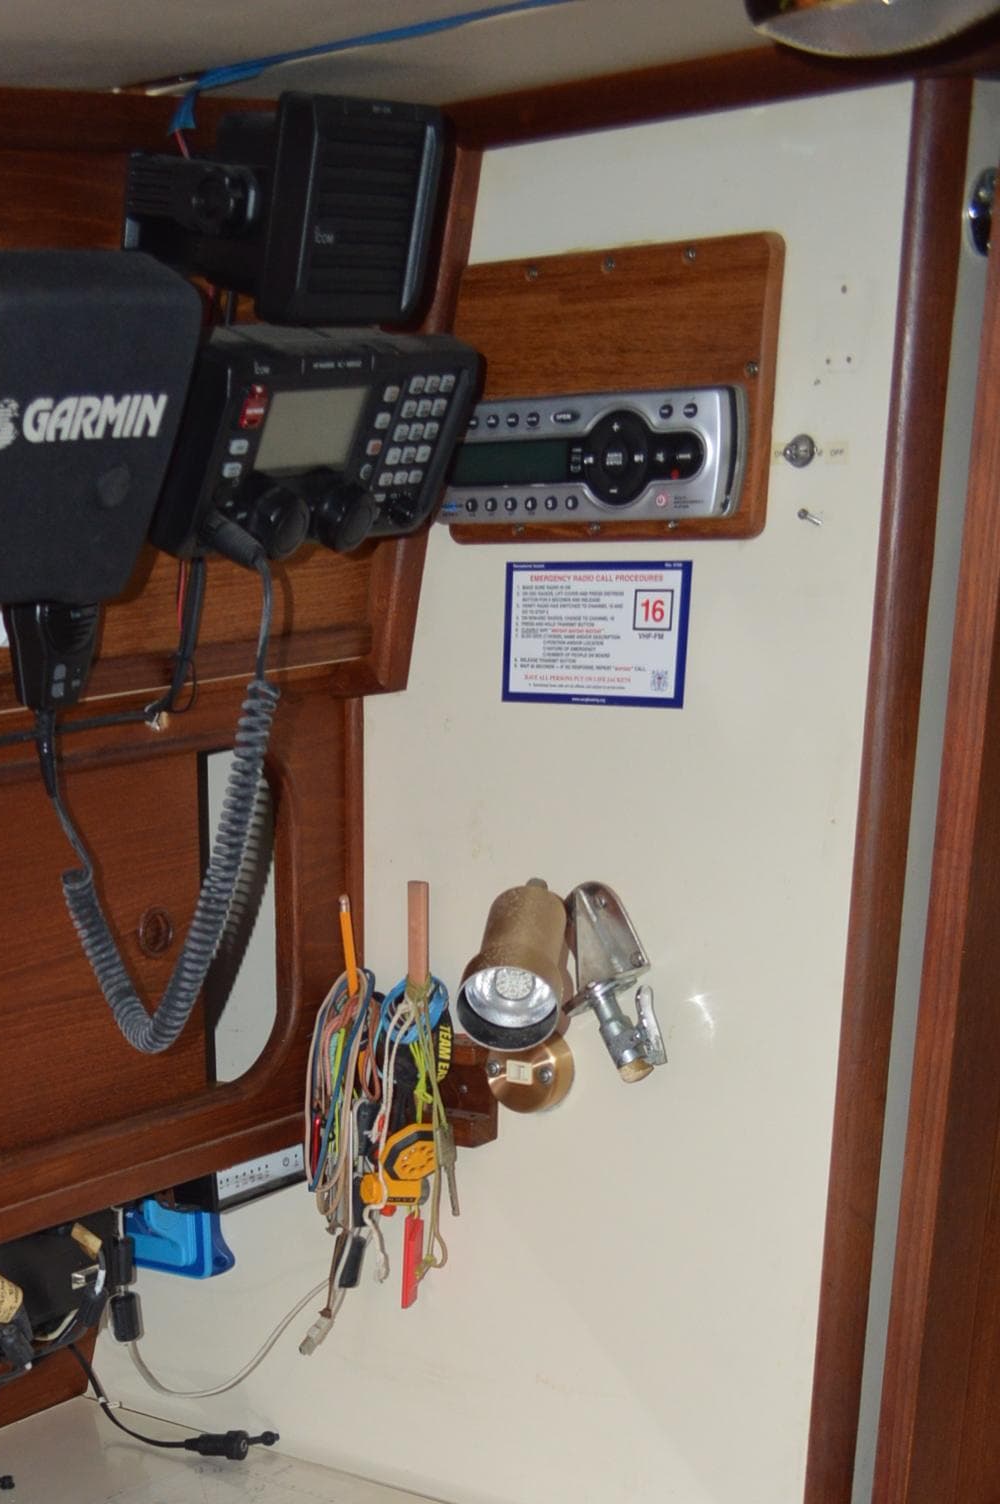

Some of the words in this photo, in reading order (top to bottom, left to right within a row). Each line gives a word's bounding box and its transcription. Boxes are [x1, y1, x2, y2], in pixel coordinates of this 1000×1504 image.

[23, 394, 168, 443] GARMIN
[530, 574, 571, 582] EMERGENCY
[573, 574, 594, 582] RADIO
[596, 574, 613, 582] CALL
[615, 574, 664, 582] PROCEDURES
[641, 599, 665, 622] 16
[439, 1025, 452, 1060] TEAM
